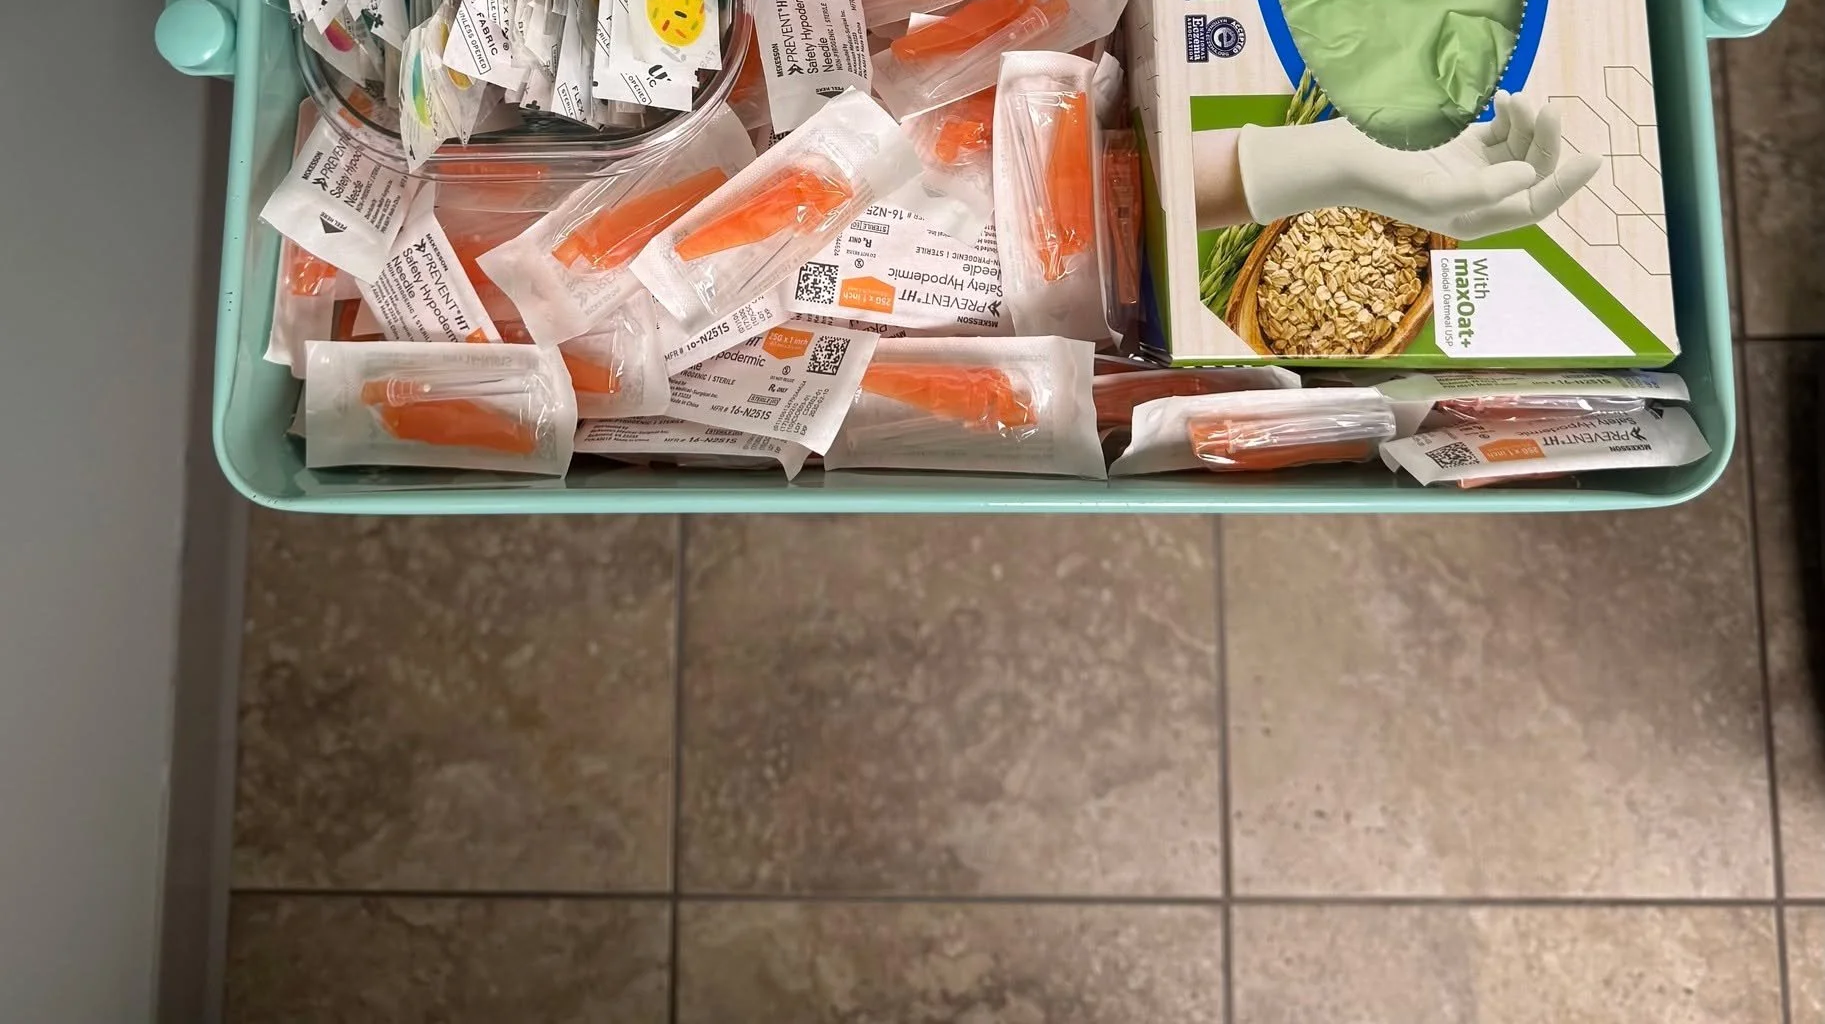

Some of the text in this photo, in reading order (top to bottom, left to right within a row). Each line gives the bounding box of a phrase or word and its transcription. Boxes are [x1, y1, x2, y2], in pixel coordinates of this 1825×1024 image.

[459, 9, 487, 69] UNLESS OPENED
[476, 12, 499, 57] FABRIC
[821, 2, 843, 70] NON-PYROGENIC STERILE
[1192, 17, 1204, 60] Eczema
[1231, 21, 1245, 54] ACCEPTED
[805, 43, 818, 74] Safety
[818, 37, 834, 72] Needle
[561, 88, 574, 117] STERILE
[572, 85, 585, 115] FLEX
[627, 75, 648, 104] OPENED
[329, 175, 351, 198] Safety
[343, 180, 364, 207] Needle
[333, 219, 347, 231] PEEL
[861, 223, 888, 234] STERILE
[915, 247, 944, 257] STERILE
[386, 262, 415, 314] NON-PYROGENIC
[391, 255, 416, 299] Needle
[888, 268, 1003, 297] Safety Hypodermic
[1472, 258, 1490, 299] With
[402, 247, 459, 343] Safety Hypoderm
[843, 290, 892, 306] 25G inch
[1440, 258, 1453, 346] Colloidal Oatmeal USP
[712, 377, 736, 385] STERILE
[711, 404, 772, 420] MFR 16-N251S
[1517, 416, 1637, 436] Safety Hypodermic
